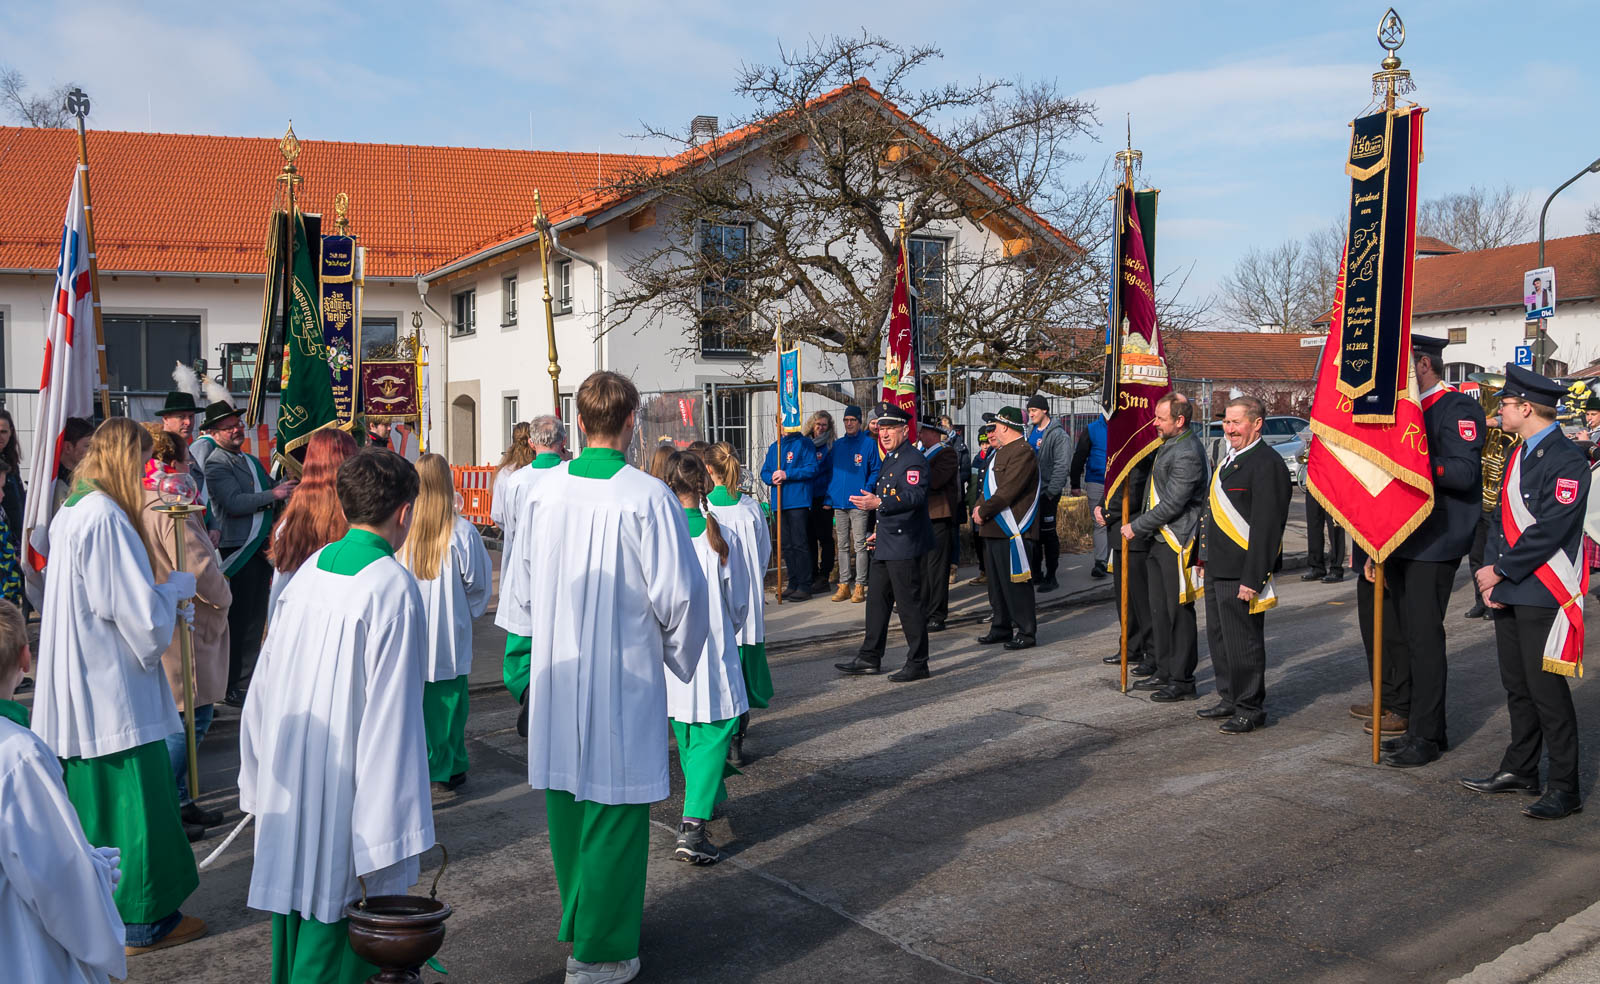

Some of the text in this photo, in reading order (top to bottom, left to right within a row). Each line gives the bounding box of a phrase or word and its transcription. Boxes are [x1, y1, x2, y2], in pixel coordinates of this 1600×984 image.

[1353, 141, 1370, 153] 150
[1517, 347, 1528, 364] P
[1118, 391, 1149, 410] Inn
